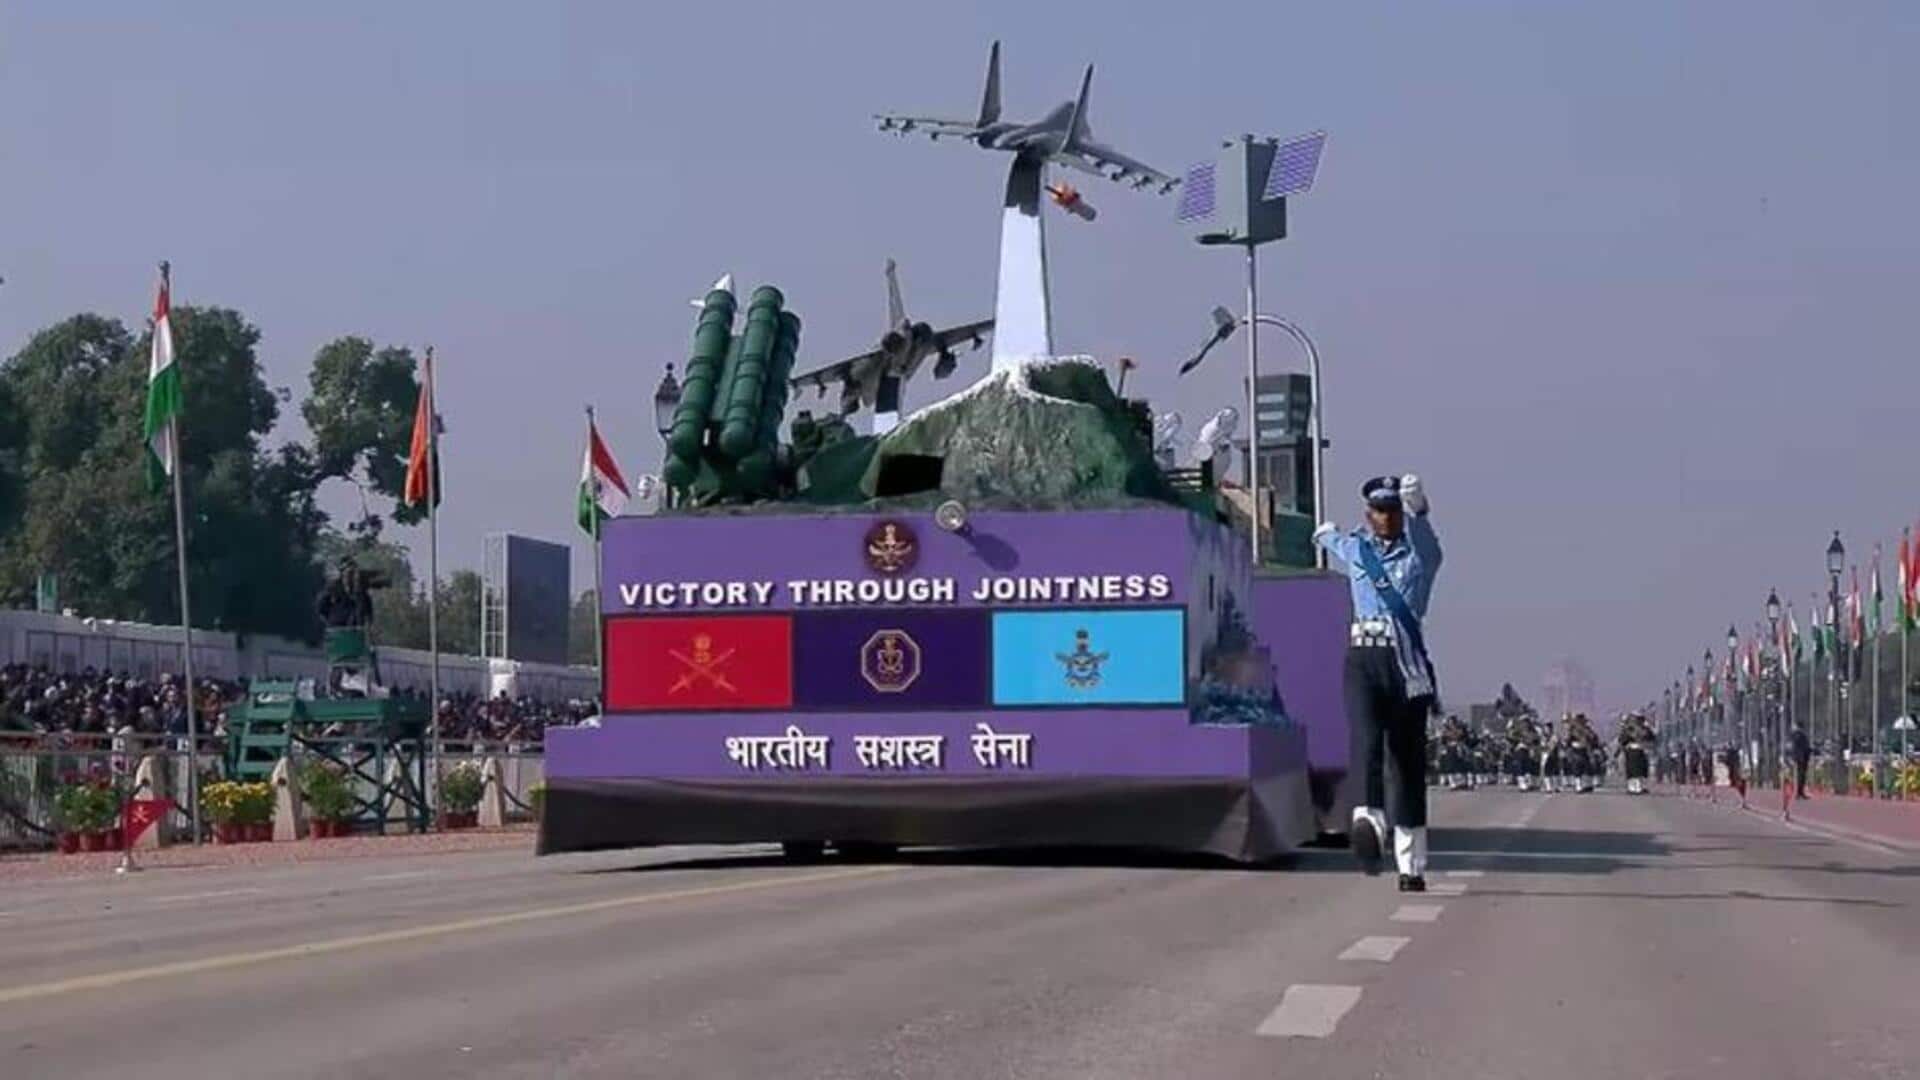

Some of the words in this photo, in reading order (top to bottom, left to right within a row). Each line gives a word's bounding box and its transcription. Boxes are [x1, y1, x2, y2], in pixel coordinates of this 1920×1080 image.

[620, 582, 773, 606] VICTORY
[788, 578, 954, 603] THROUGH
[972, 574, 1170, 600] JOINTNESS
[725, 725, 828, 768] भारतीय
[853, 734, 944, 768] सशस्त्र
[970, 723, 1032, 766] सेना
